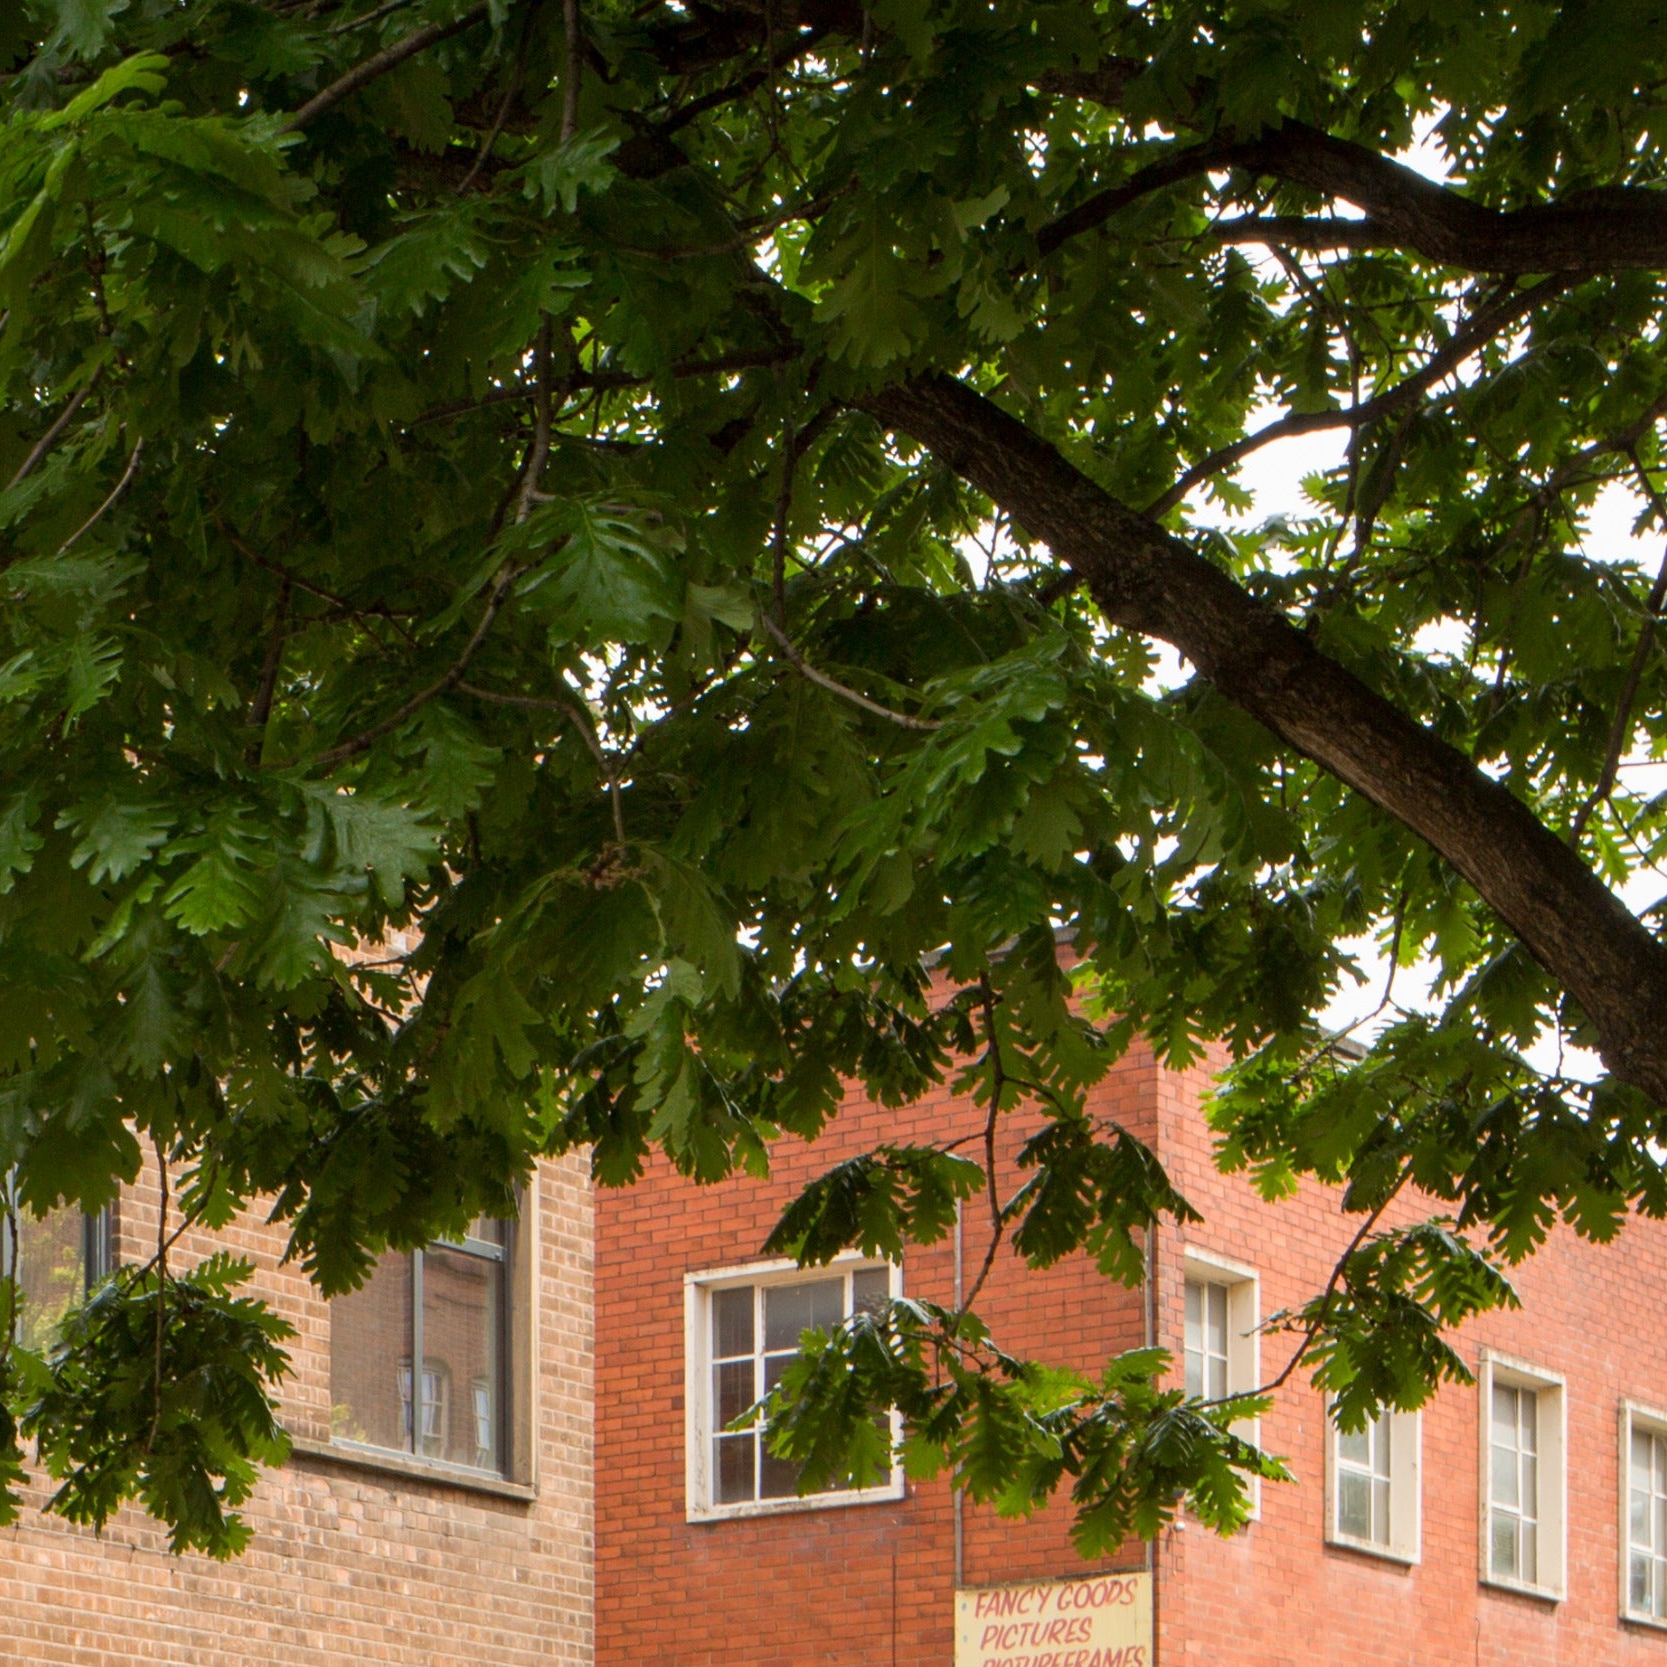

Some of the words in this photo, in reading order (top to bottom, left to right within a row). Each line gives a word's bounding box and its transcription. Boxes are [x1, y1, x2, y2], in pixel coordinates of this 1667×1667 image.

[975, 1587, 1052, 1619] FANCY
[1057, 1578, 1138, 1611] GOODS
[980, 1616, 1092, 1651] PICTURES
